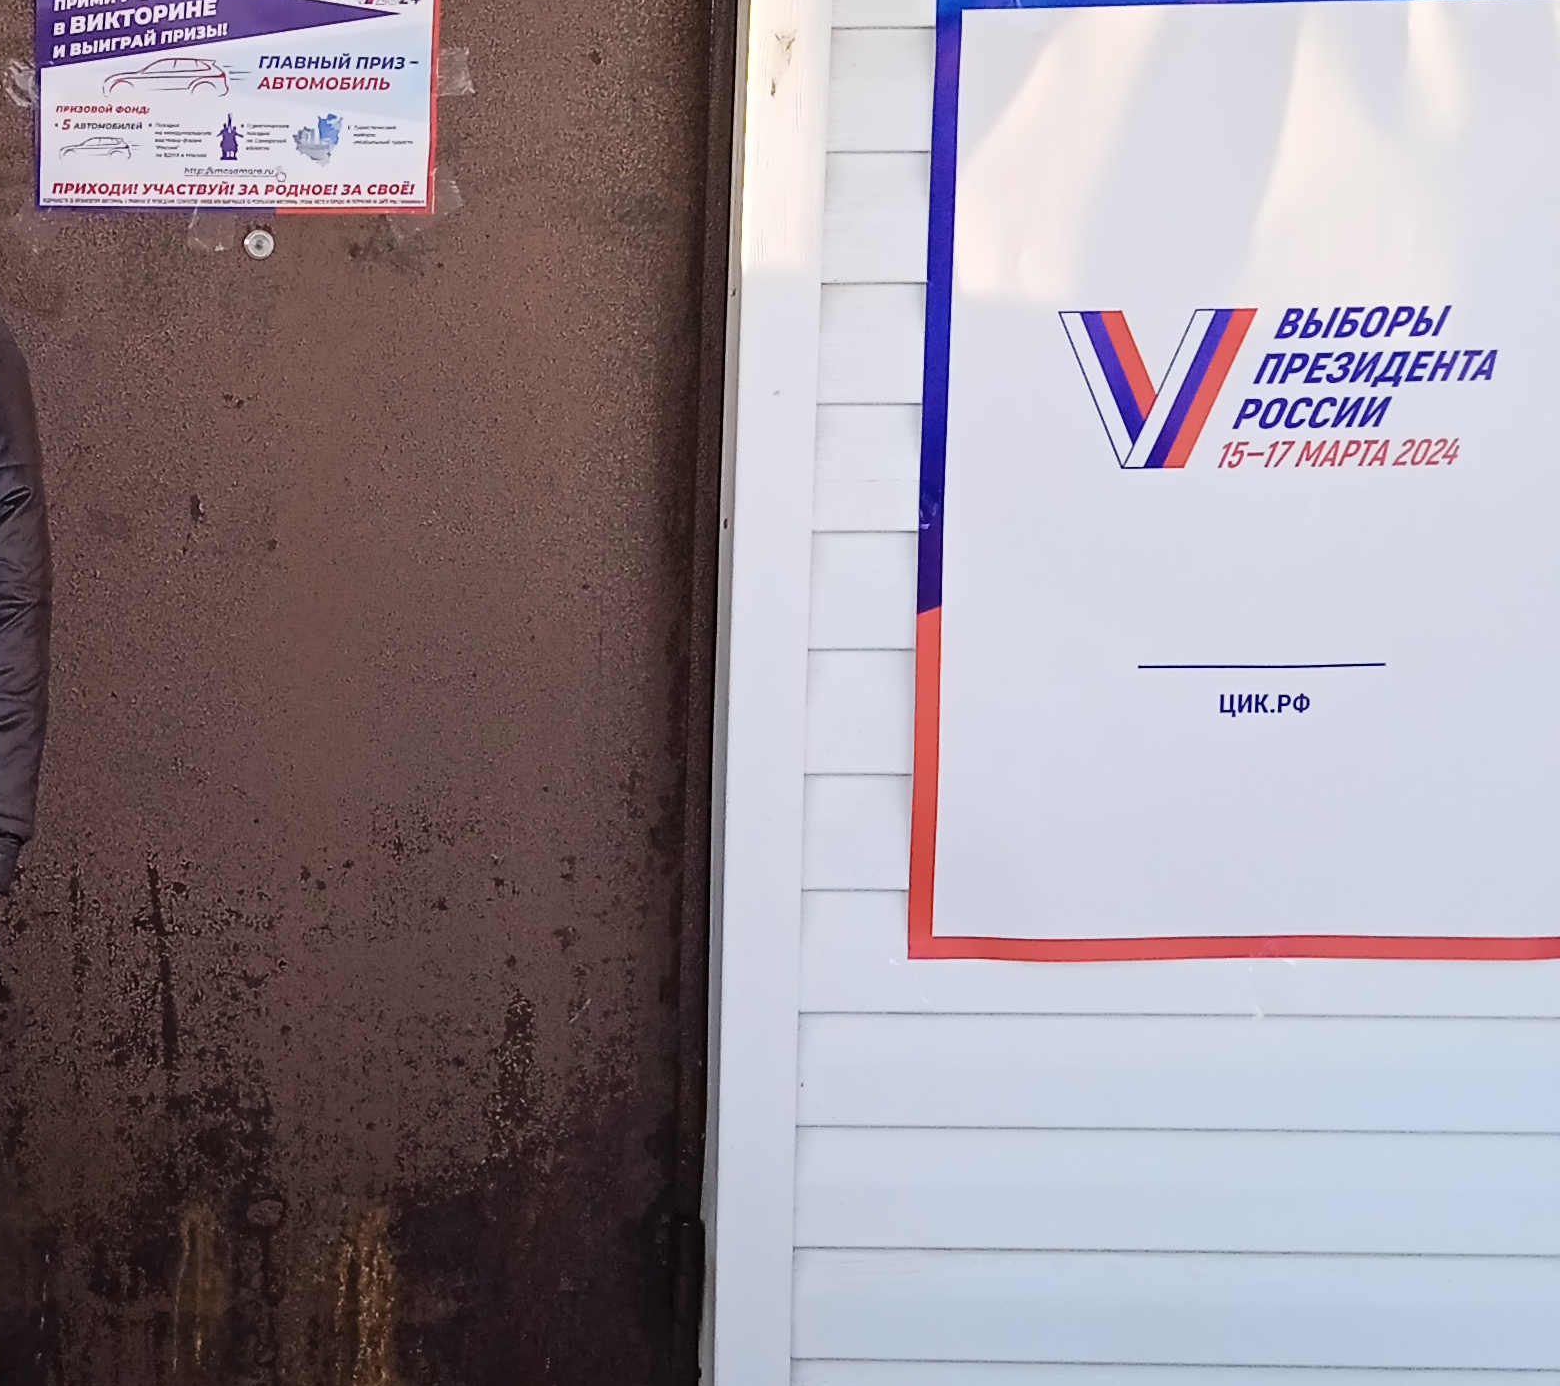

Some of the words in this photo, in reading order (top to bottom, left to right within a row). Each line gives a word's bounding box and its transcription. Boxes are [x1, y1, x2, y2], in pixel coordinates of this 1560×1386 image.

[52, 44, 66, 59] И
[69, 29, 157, 57] ВЫИГРАЙ
[160, 22, 228, 44] ПРИЗЫ!
[258, 53, 352, 70] ГЛАВНЫЙ
[355, 56, 406, 70] ПРИЗ
[257, 76, 391, 91] АВТОМОБИЛЬ
[55, 104, 113, 114] ПРИЗОВОЙ
[115, 105, 151, 115] ФОНД:
[61, 119, 71, 130] 5
[73, 121, 143, 130] АВТОМОБИЛЕЙ
[51, 182, 138, 197] ПРИХОДИ!
[141, 180, 235, 196] УЧАСТВУЙ!
[238, 183, 260, 196] ЗА
[264, 183, 338, 197] РОДНОЕ!
[340, 183, 362, 196] ЗА
[366, 180, 416, 196] СВОЁ!
[1273, 305, 1452, 340] ВЫБОРЫ
[1252, 349, 1498, 388] ПРЕЗИДЕНТА
[1232, 395, 1393, 430] РОССИИ
[1295, 439, 1390, 468] МАРТА
[1391, 438, 1461, 467] 2024
[1218, 693, 1311, 718] ЦИК.РФ
